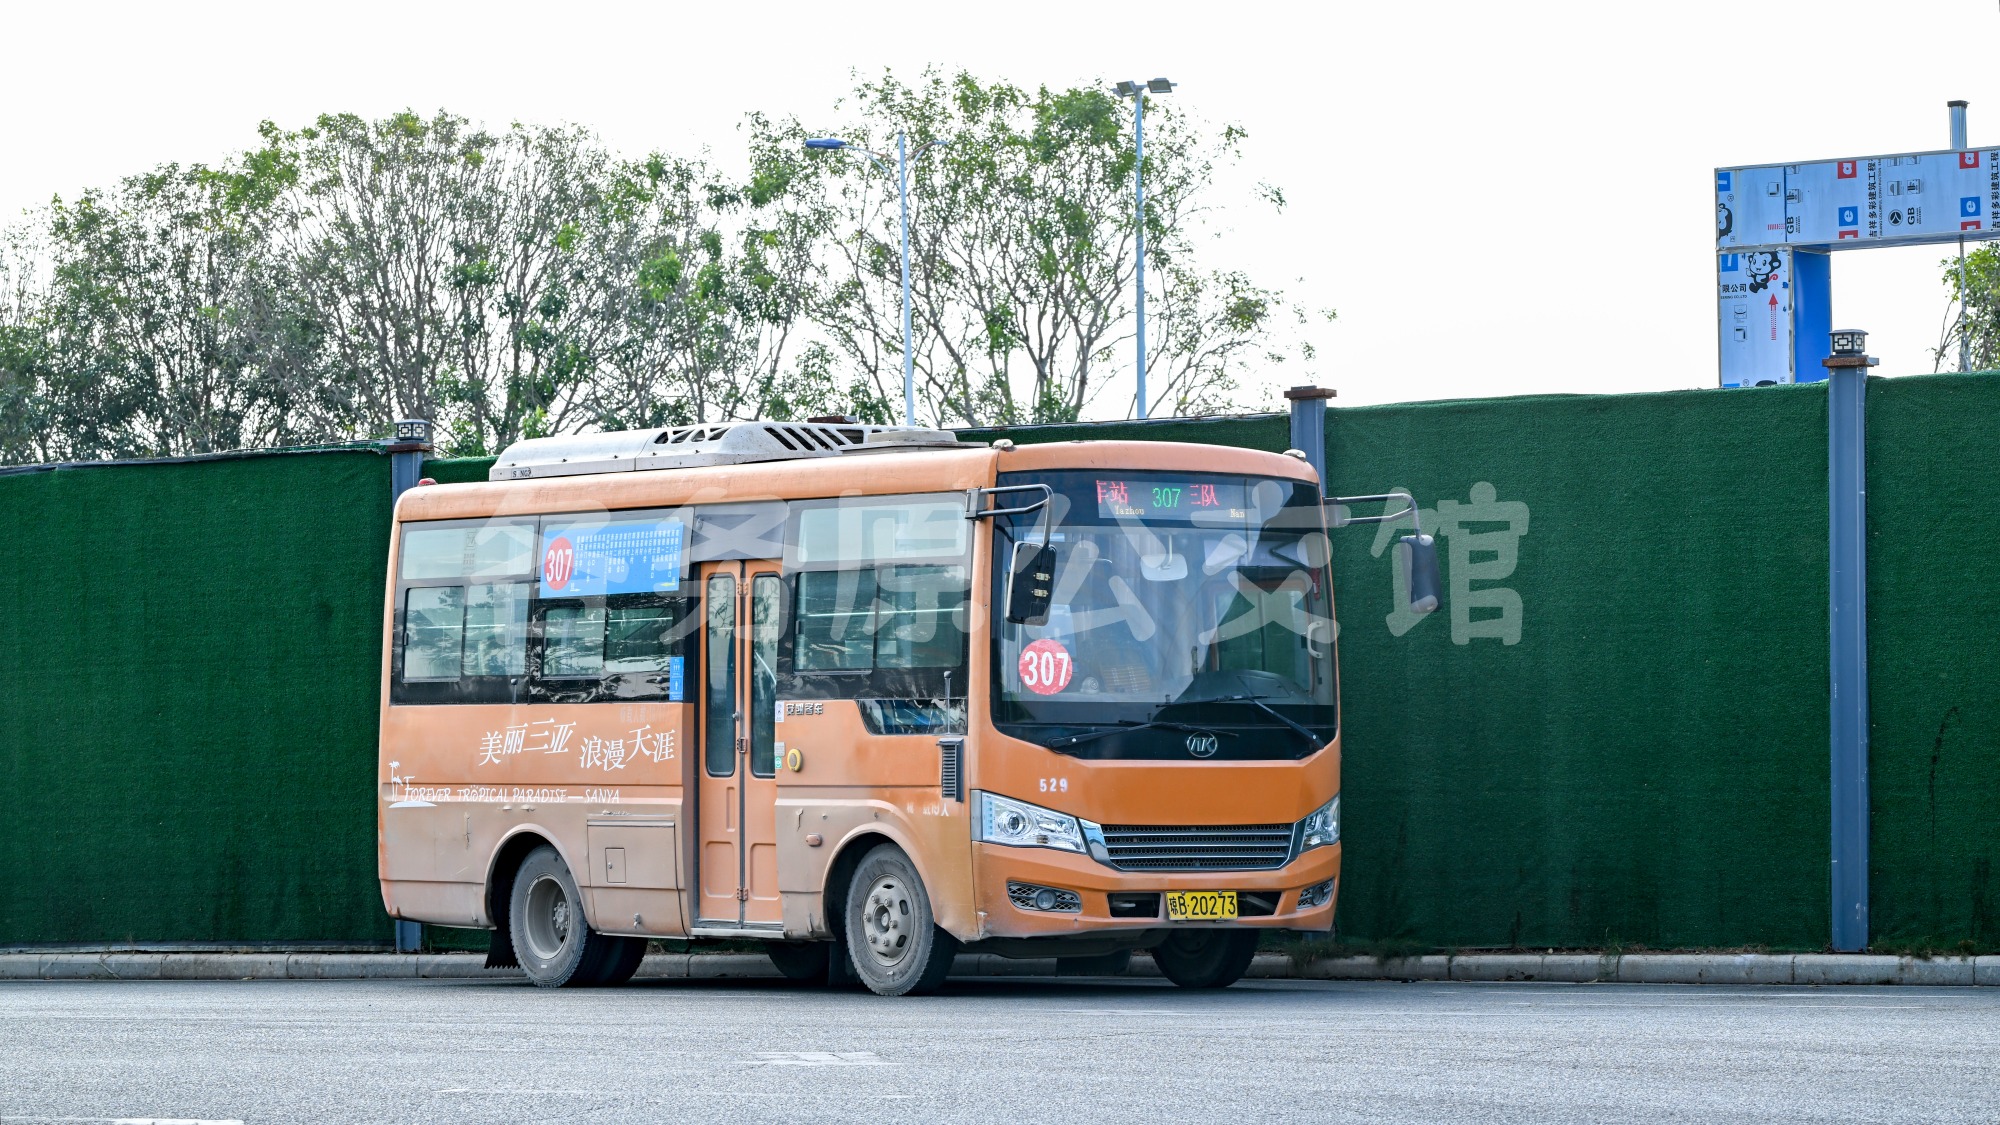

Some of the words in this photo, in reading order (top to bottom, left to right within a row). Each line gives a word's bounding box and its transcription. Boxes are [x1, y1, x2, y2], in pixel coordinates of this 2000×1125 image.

[1867, 159, 1877, 237] 吉祥多彩建筑工程
[1991, 151, 2000, 229] 吉祥多彩建筑工程
[1786, 216, 1794, 234] GB
[1908, 207, 1915, 225] GB
[1721, 283, 1747, 293] 限公司
[1152, 487, 1181, 508] 307
[1114, 505, 1145, 516] Yazhou
[546, 548, 573, 583] 307
[1024, 650, 1069, 687] 307
[479, 717, 577, 767] 美丽三亚
[579, 724, 677, 772] 浪漫天涯
[457, 785, 510, 803] TROPICAL
[1039, 777, 1068, 793] 529
